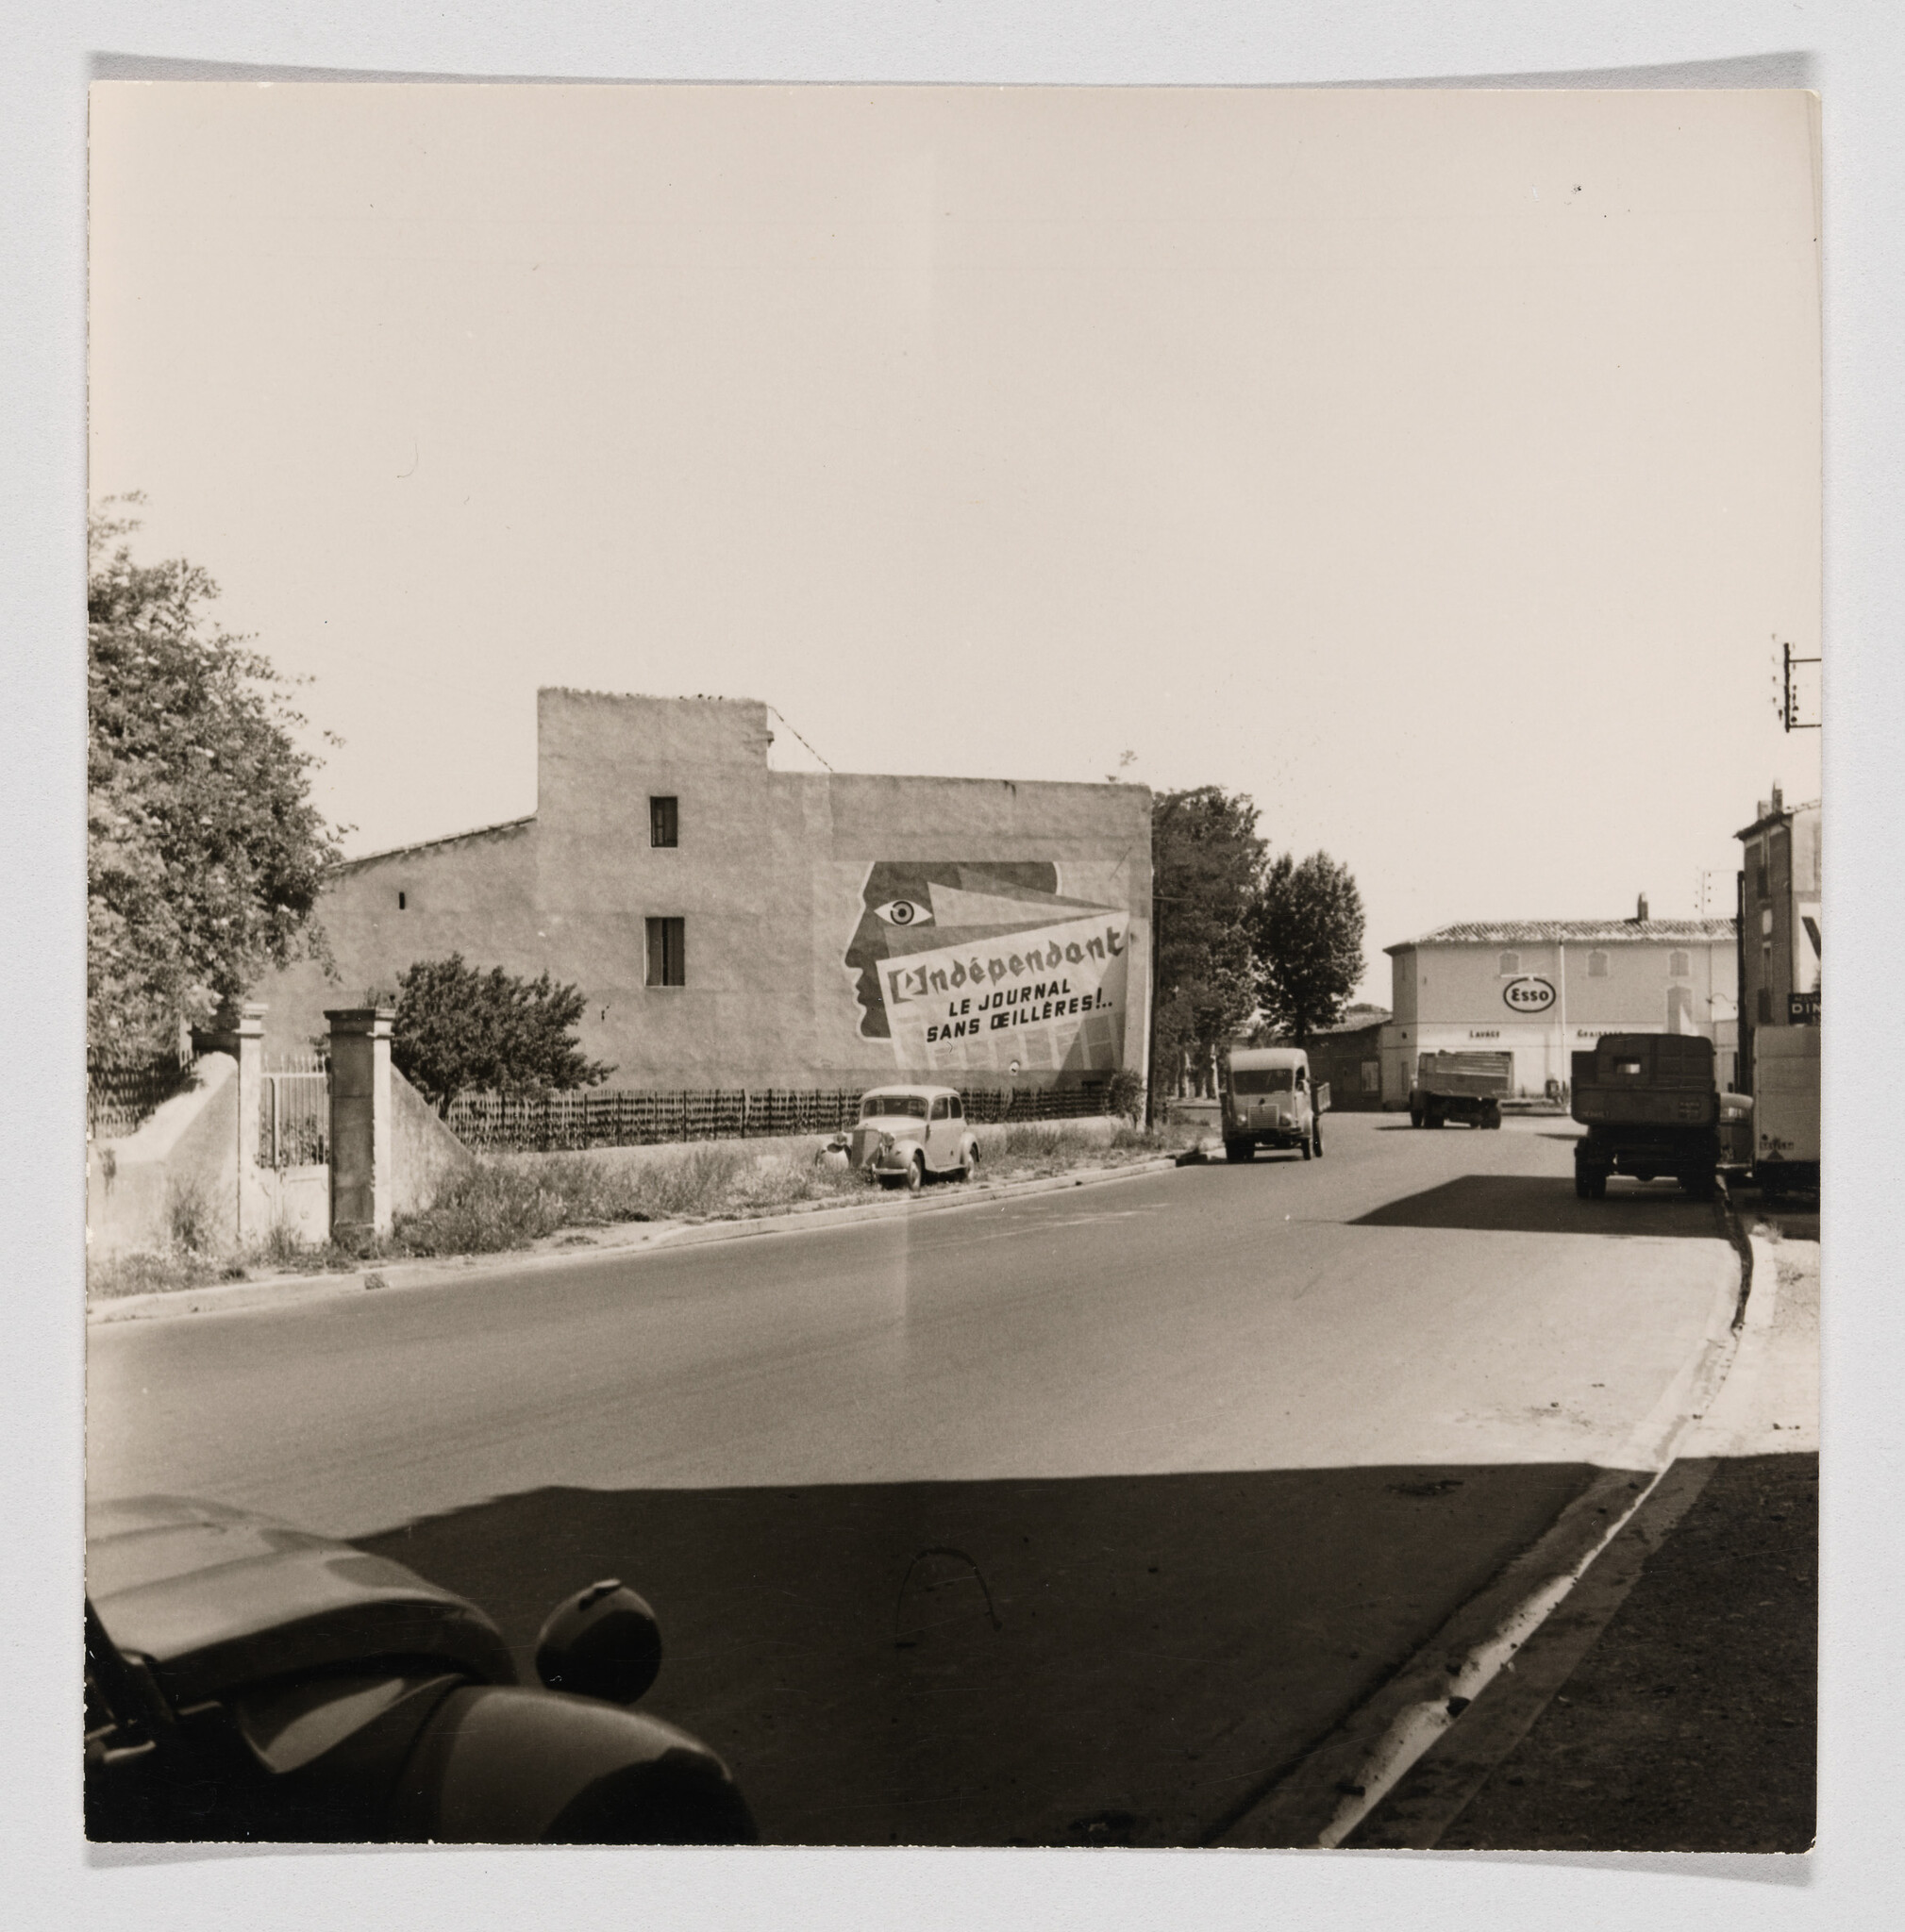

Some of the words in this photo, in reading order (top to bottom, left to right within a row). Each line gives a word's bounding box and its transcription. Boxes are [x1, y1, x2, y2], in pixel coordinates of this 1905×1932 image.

[949, 999, 971, 1017] LE
[978, 978, 1071, 1011] JOURNAL
[927, 1018, 980, 1042] SANS
